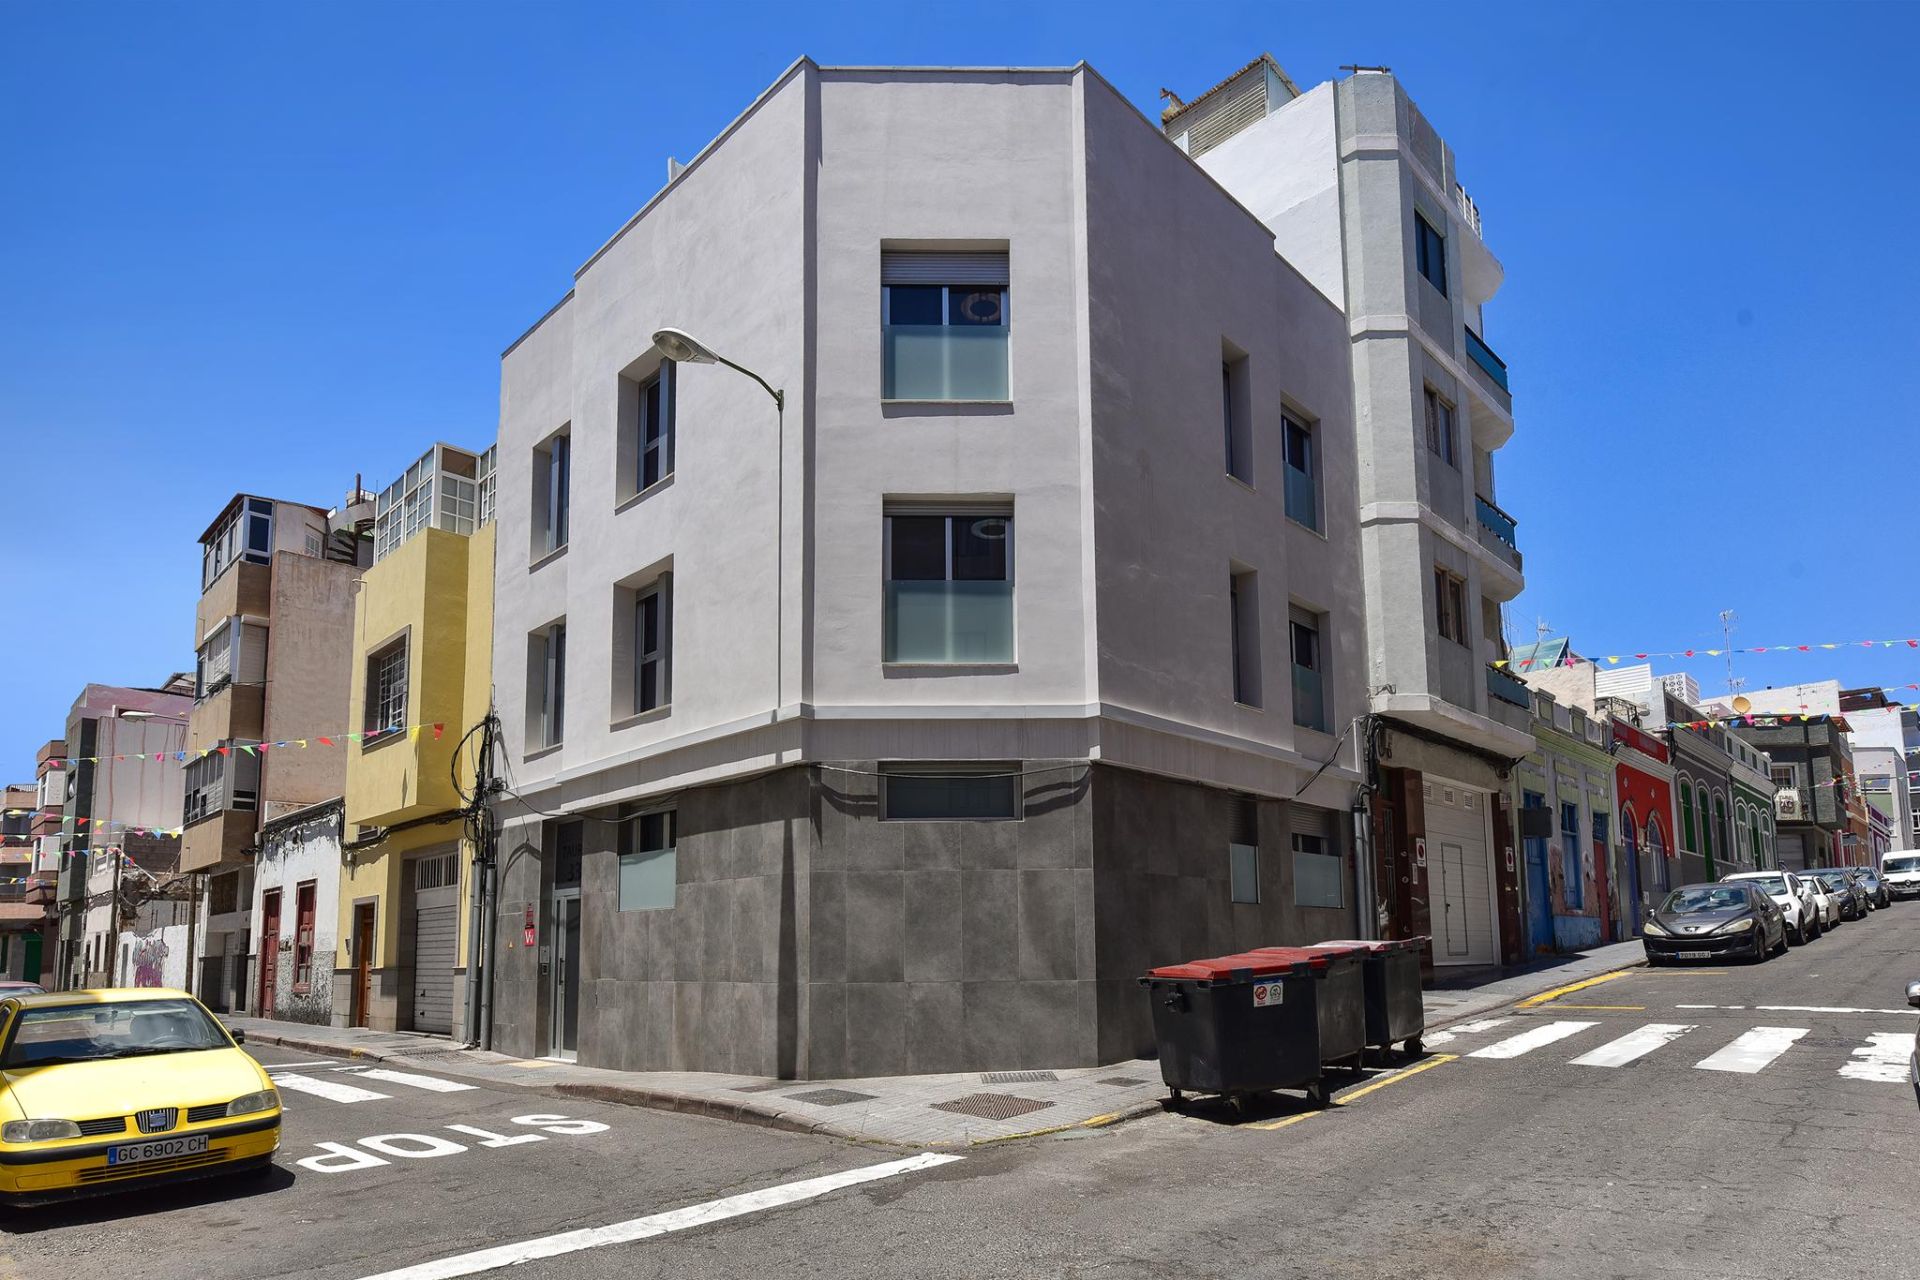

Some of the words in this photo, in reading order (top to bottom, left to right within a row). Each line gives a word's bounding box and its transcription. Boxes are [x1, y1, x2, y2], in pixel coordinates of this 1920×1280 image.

[118, 1147, 138, 1161] GC
[143, 1140, 184, 1158] 6902
[188, 1136, 207, 1151] CH
[296, 1114, 610, 1173] STOP
